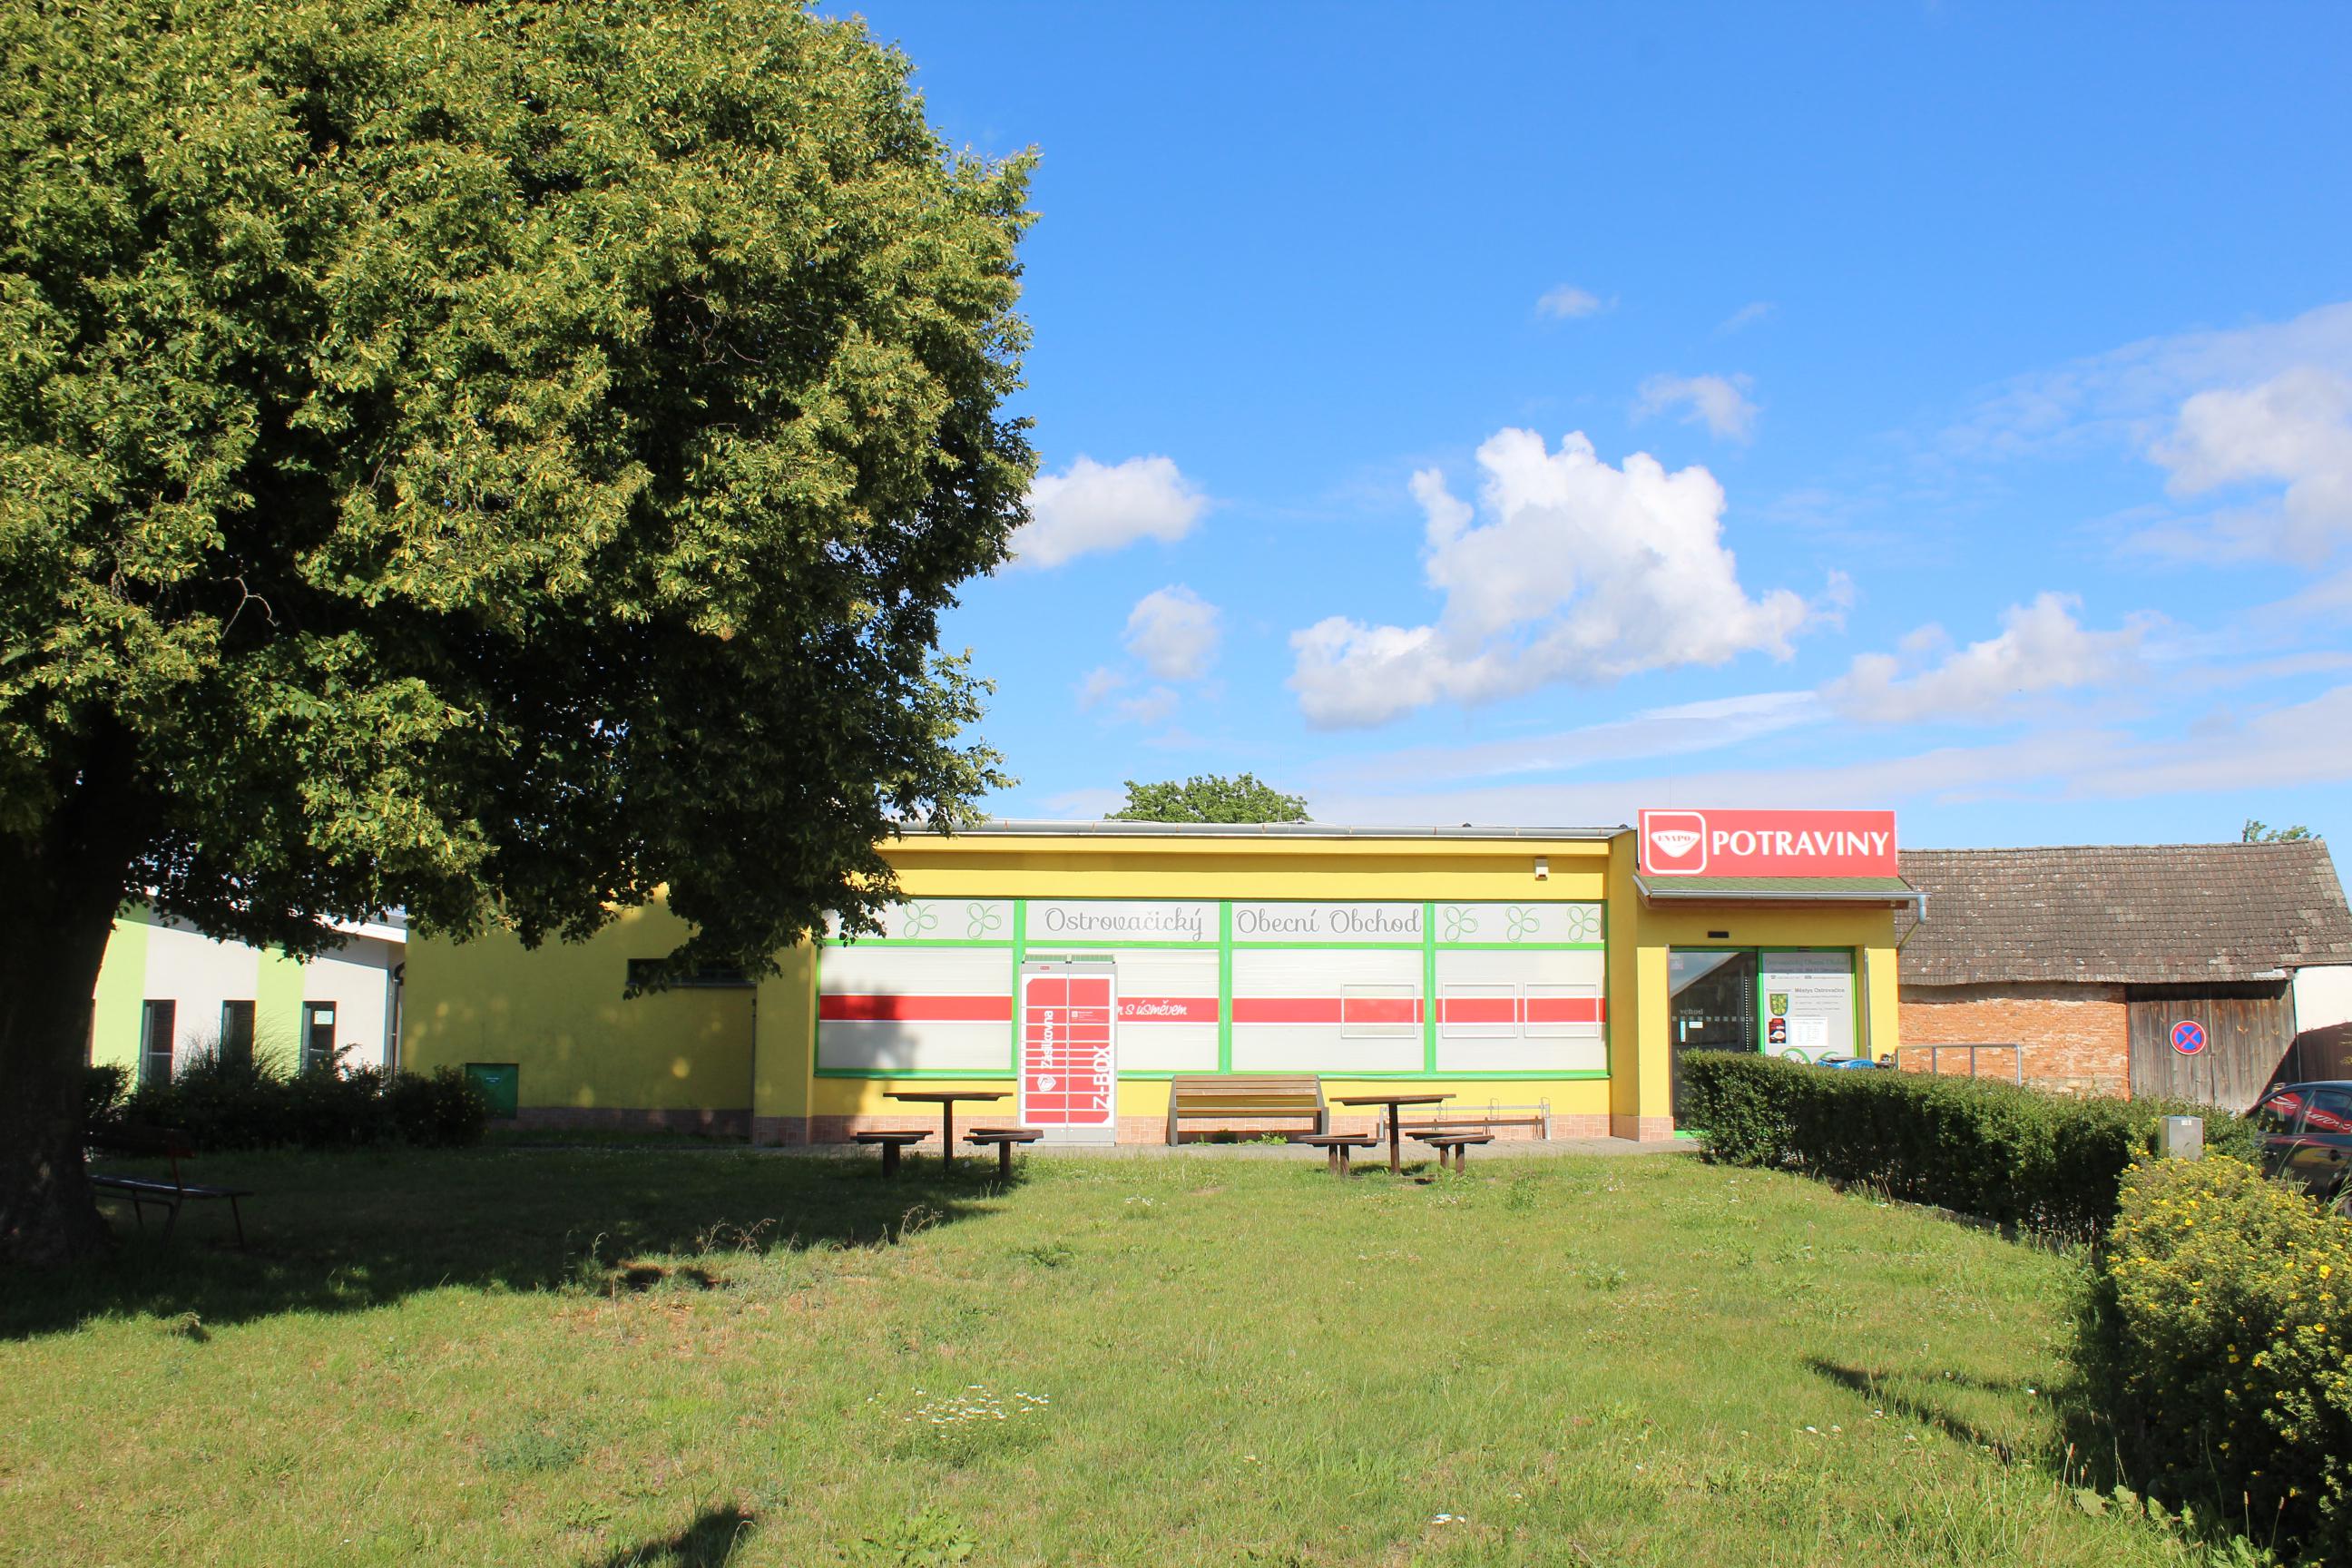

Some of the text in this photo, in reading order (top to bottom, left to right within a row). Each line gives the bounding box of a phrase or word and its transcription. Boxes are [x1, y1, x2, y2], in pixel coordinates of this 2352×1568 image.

[1712, 829, 1889, 857] POTRAVINY
[1044, 906, 1422, 943] Ostrovačický Obecní Obchod
[1125, 1004, 1135, 1015] s
[1136, 999, 1188, 1016] úsměvem
[1041, 1010, 1054, 1070] Zásilkovna
[1093, 1045, 1110, 1110] Z-BOX
